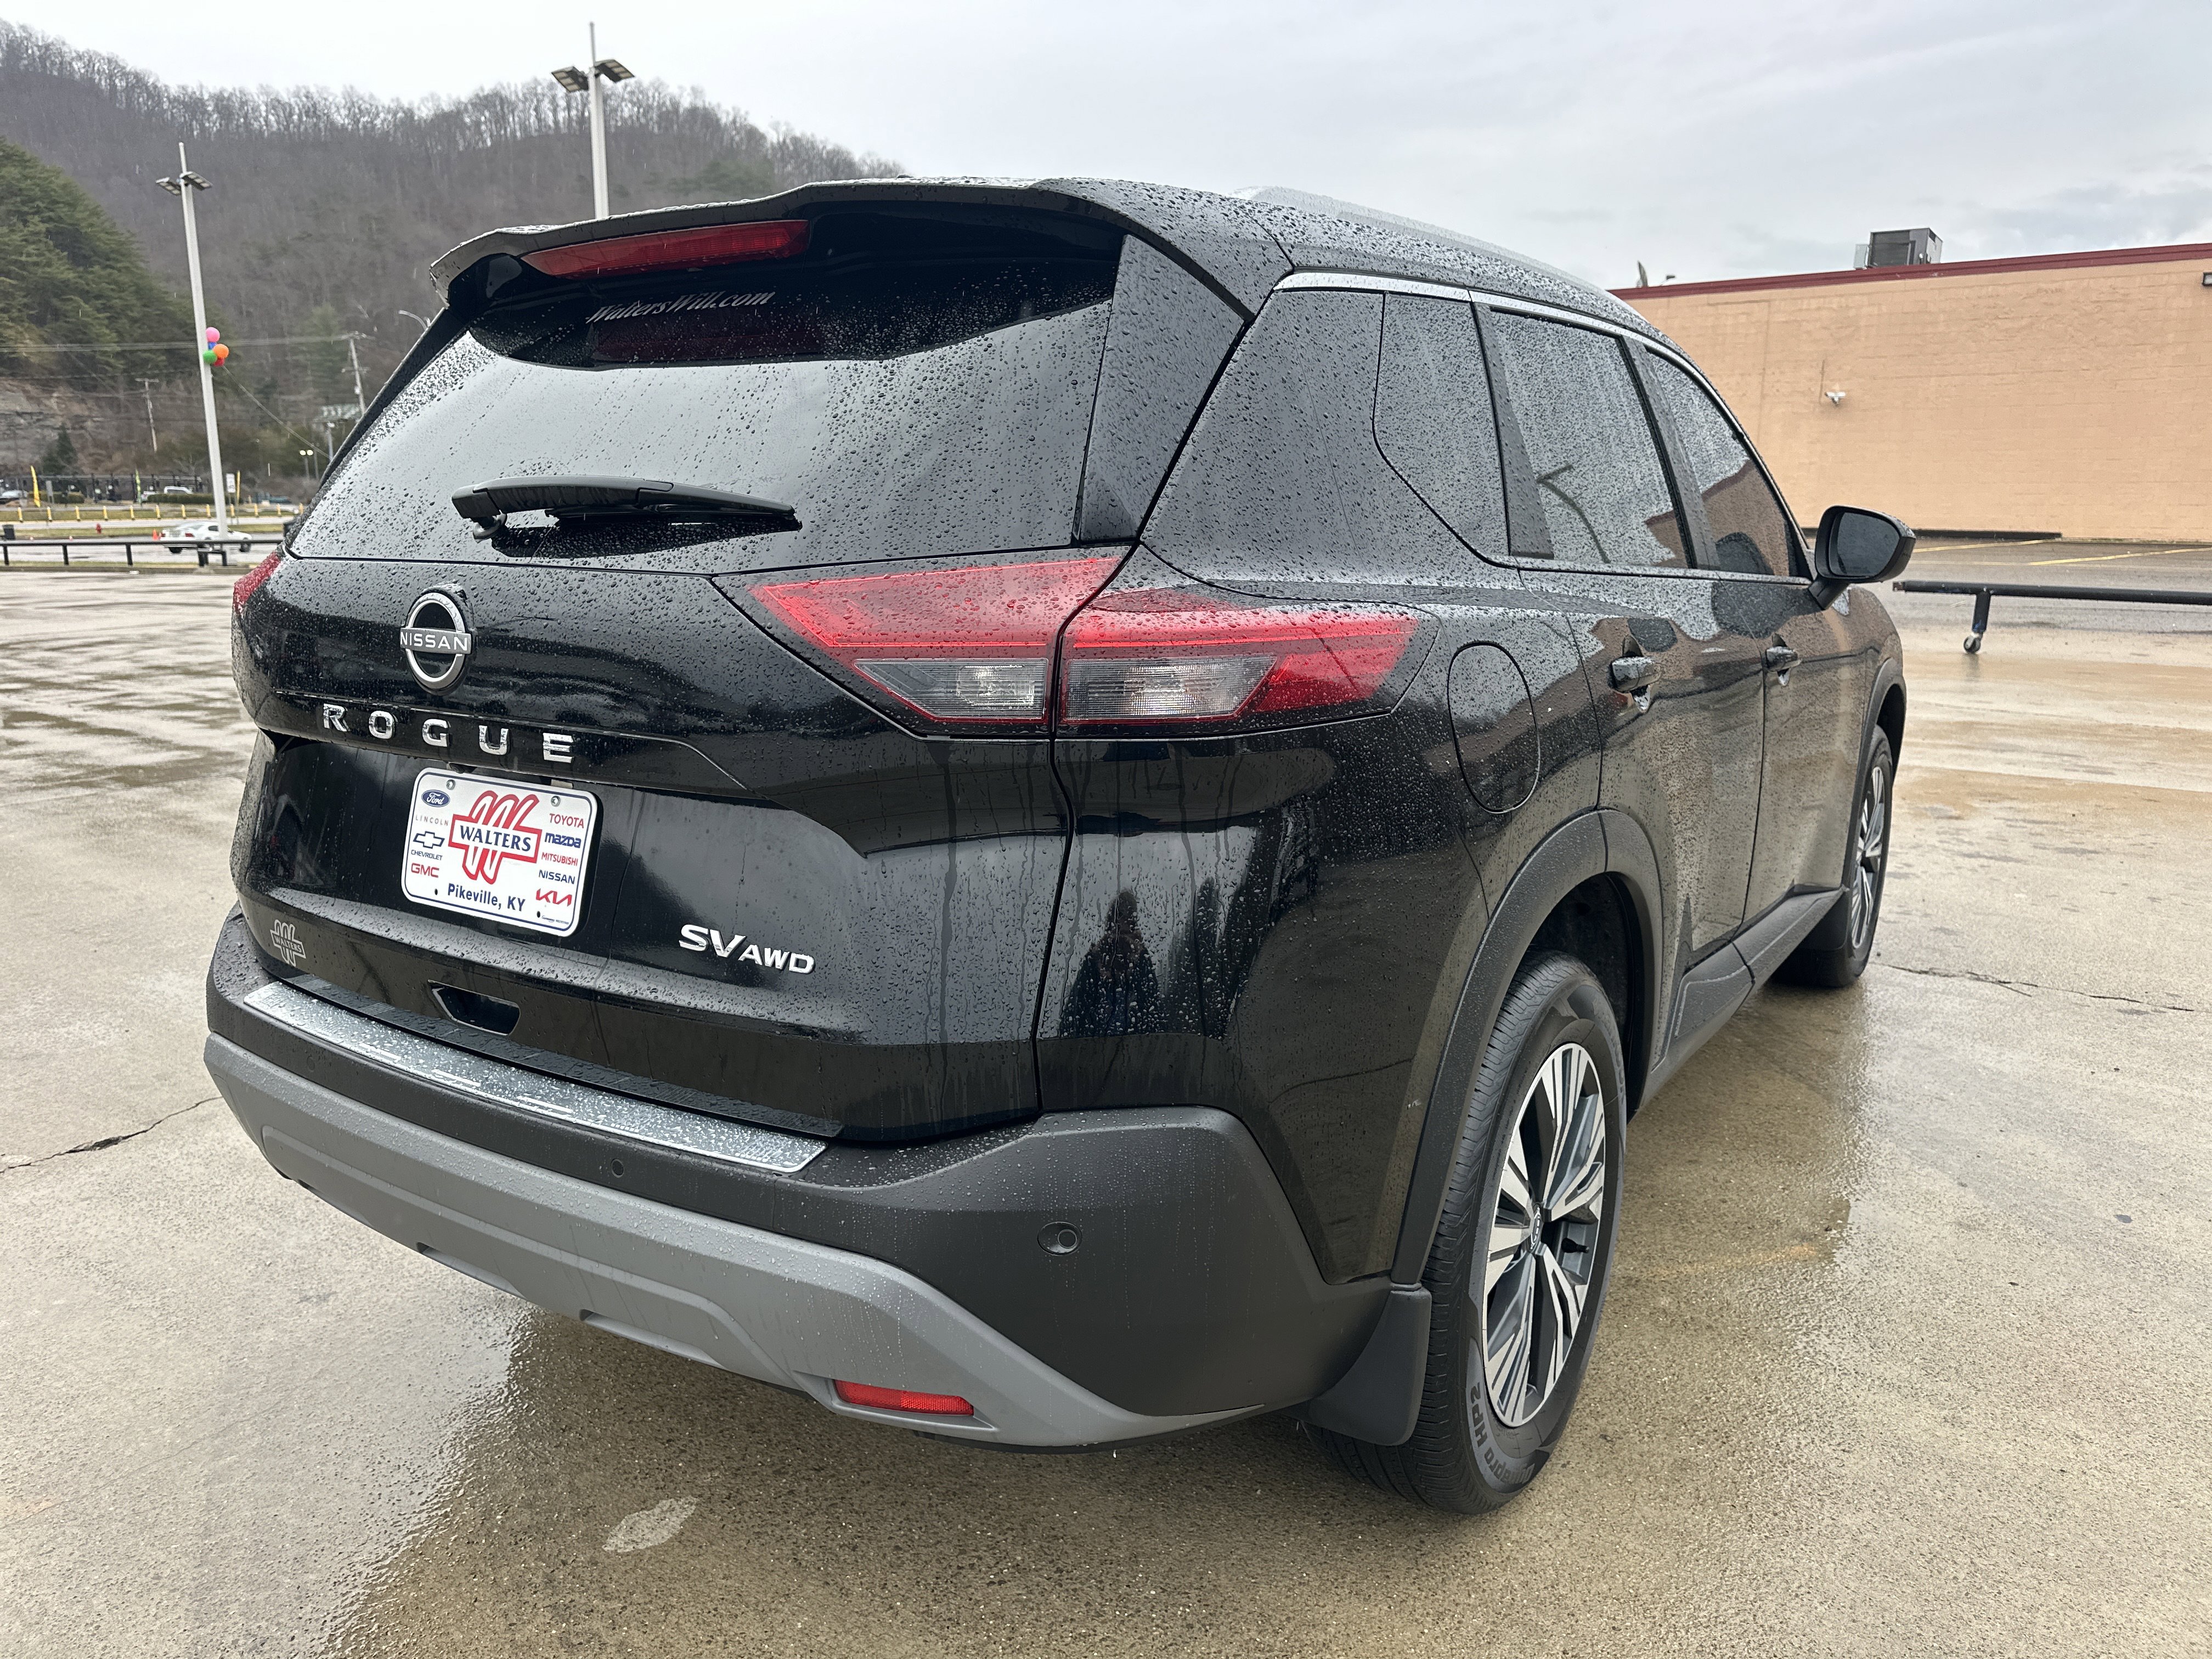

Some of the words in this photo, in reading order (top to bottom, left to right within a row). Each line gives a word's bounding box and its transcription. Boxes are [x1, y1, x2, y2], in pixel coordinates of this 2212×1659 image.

[585, 291, 776, 324] WaltersWill.com
[400, 631, 468, 651] NISSAN
[323, 703, 575, 764] ROGUE
[426, 791, 444, 805] Ford
[415, 815, 449, 826] LINCOLN
[549, 814, 584, 829] TOYOTA
[460, 825, 531, 851] WALTERS
[411, 849, 443, 861] CHEVROLET
[541, 851, 579, 867] MITSUBISHI
[410, 862, 439, 878] GMC
[538, 870, 575, 884] NISSAN
[448, 883, 501, 910] Pikeville,
[507, 895, 526, 912] KY
[274, 936, 302, 952] WALTERS
[679, 924, 746, 958] SV
[738, 944, 815, 974] AWD
[1470, 1382, 1488, 1448] HP2
